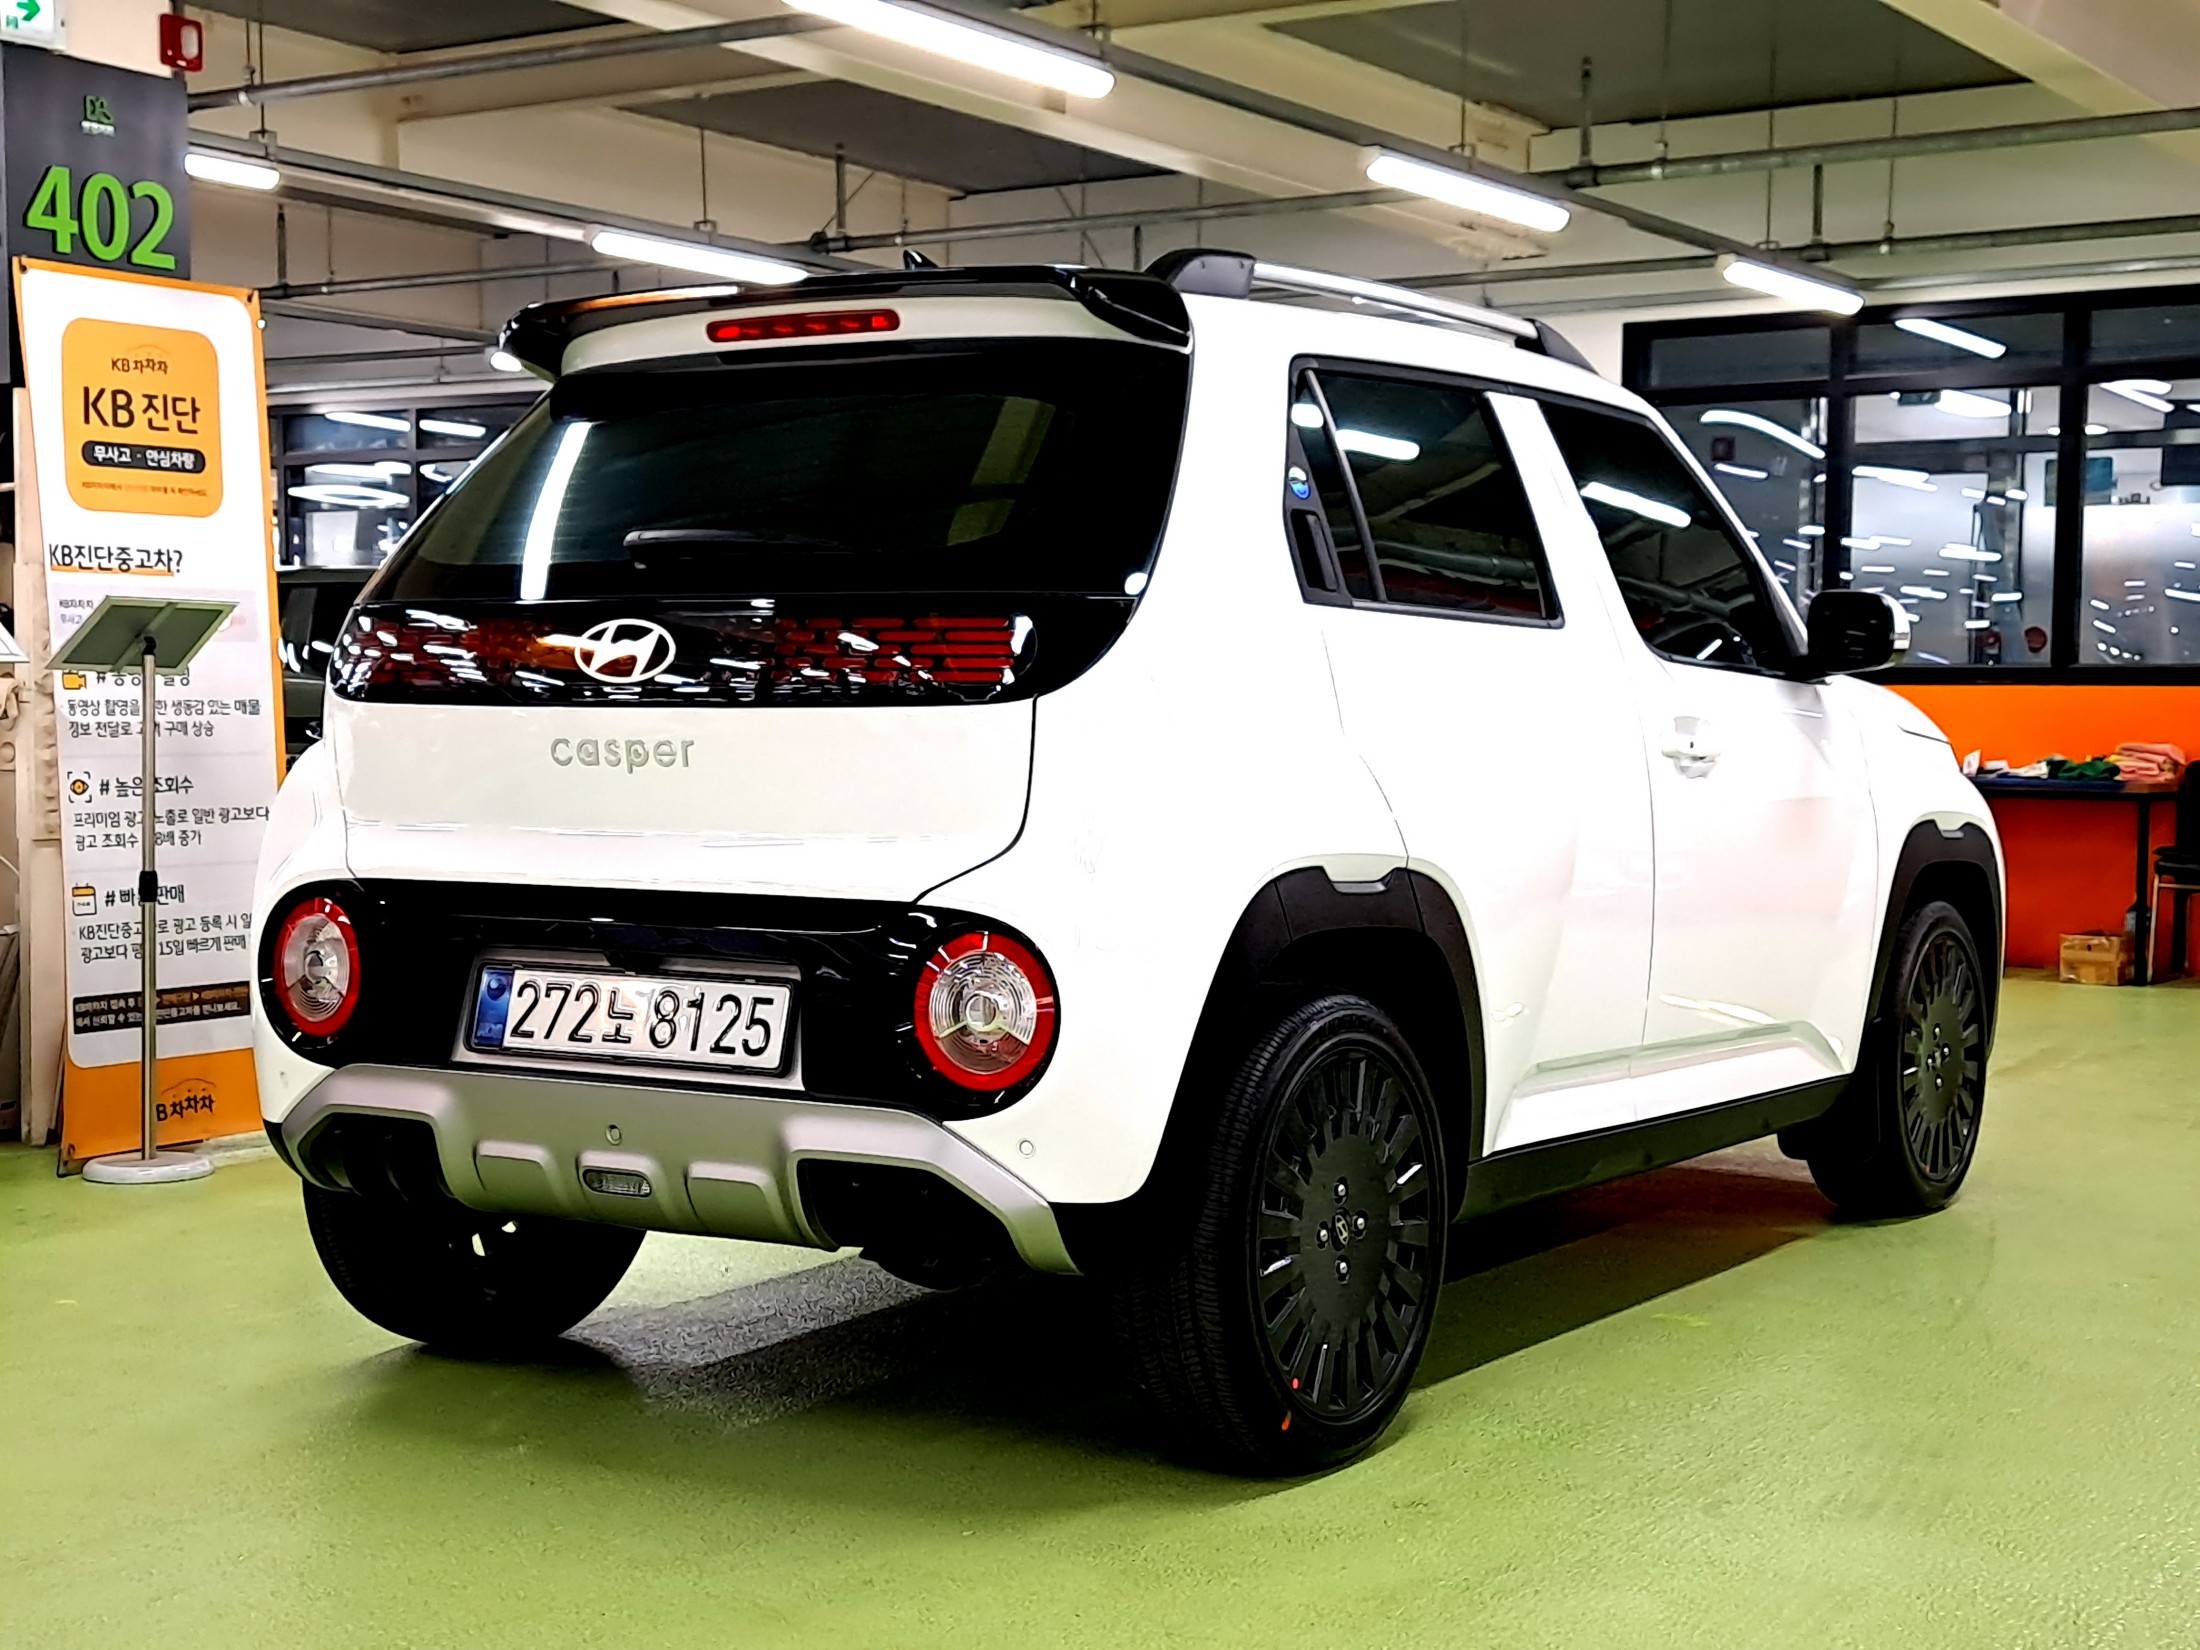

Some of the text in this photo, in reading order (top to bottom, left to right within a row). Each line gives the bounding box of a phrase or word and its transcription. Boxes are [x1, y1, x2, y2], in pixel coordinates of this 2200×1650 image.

[26, 165, 176, 270] 402
[94, 445, 132, 463] 무사고
[49, 543, 183, 574] KB진단중고차?
[67, 699, 101, 717] 동영상
[105, 699, 141, 717] 촬영을
[171, 699, 205, 717] 생동감
[207, 699, 232, 716] 있는
[95, 721, 134, 739] 전달로
[164, 721, 189, 737] 구매
[191, 720, 215, 738] 상승
[550, 737, 695, 775] casper
[114, 776, 143, 798] 높은
[73, 811, 121, 829] 프리미엄
[191, 807, 216, 825] 일반
[218, 805, 270, 825] 광고보다
[101, 832, 140, 849] 조회수
[178, 829, 202, 847] 증가
[157, 884, 185, 906] 판매
[172, 917, 197, 935] 광고
[225, 914, 238, 930] 시
[80, 943, 129, 965] 광고보다
[223, 934, 247, 952] 판매
